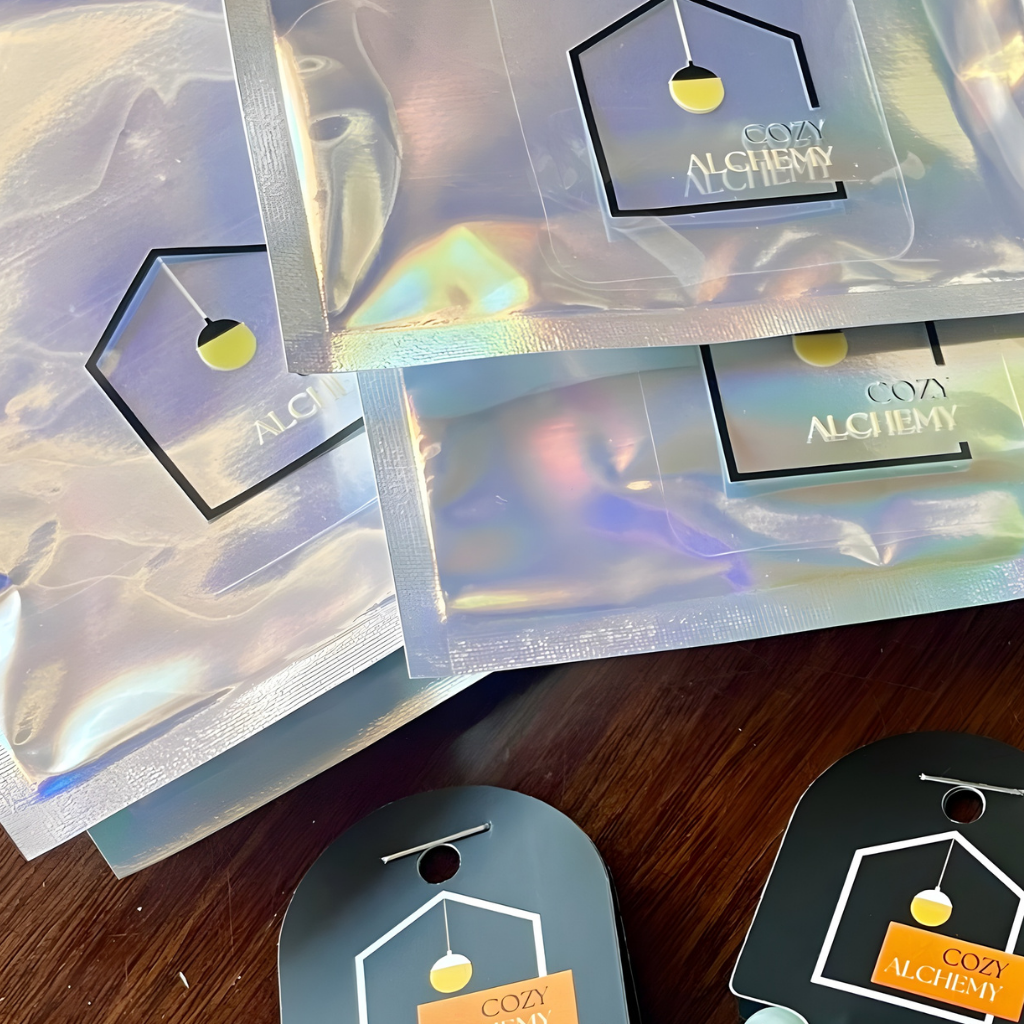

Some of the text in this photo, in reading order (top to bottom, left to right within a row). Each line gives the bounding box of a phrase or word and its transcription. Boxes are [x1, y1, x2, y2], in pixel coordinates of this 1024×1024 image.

[741, 119, 825, 145] COZY
[686, 145, 833, 178] ALCHEMY
[867, 377, 949, 404] COZY
[806, 405, 957, 443] ALCHEMY
[942, 948, 1009, 979] COZY
[884, 957, 1003, 1002] ALCHEMY
[481, 986, 549, 1017] COZY
